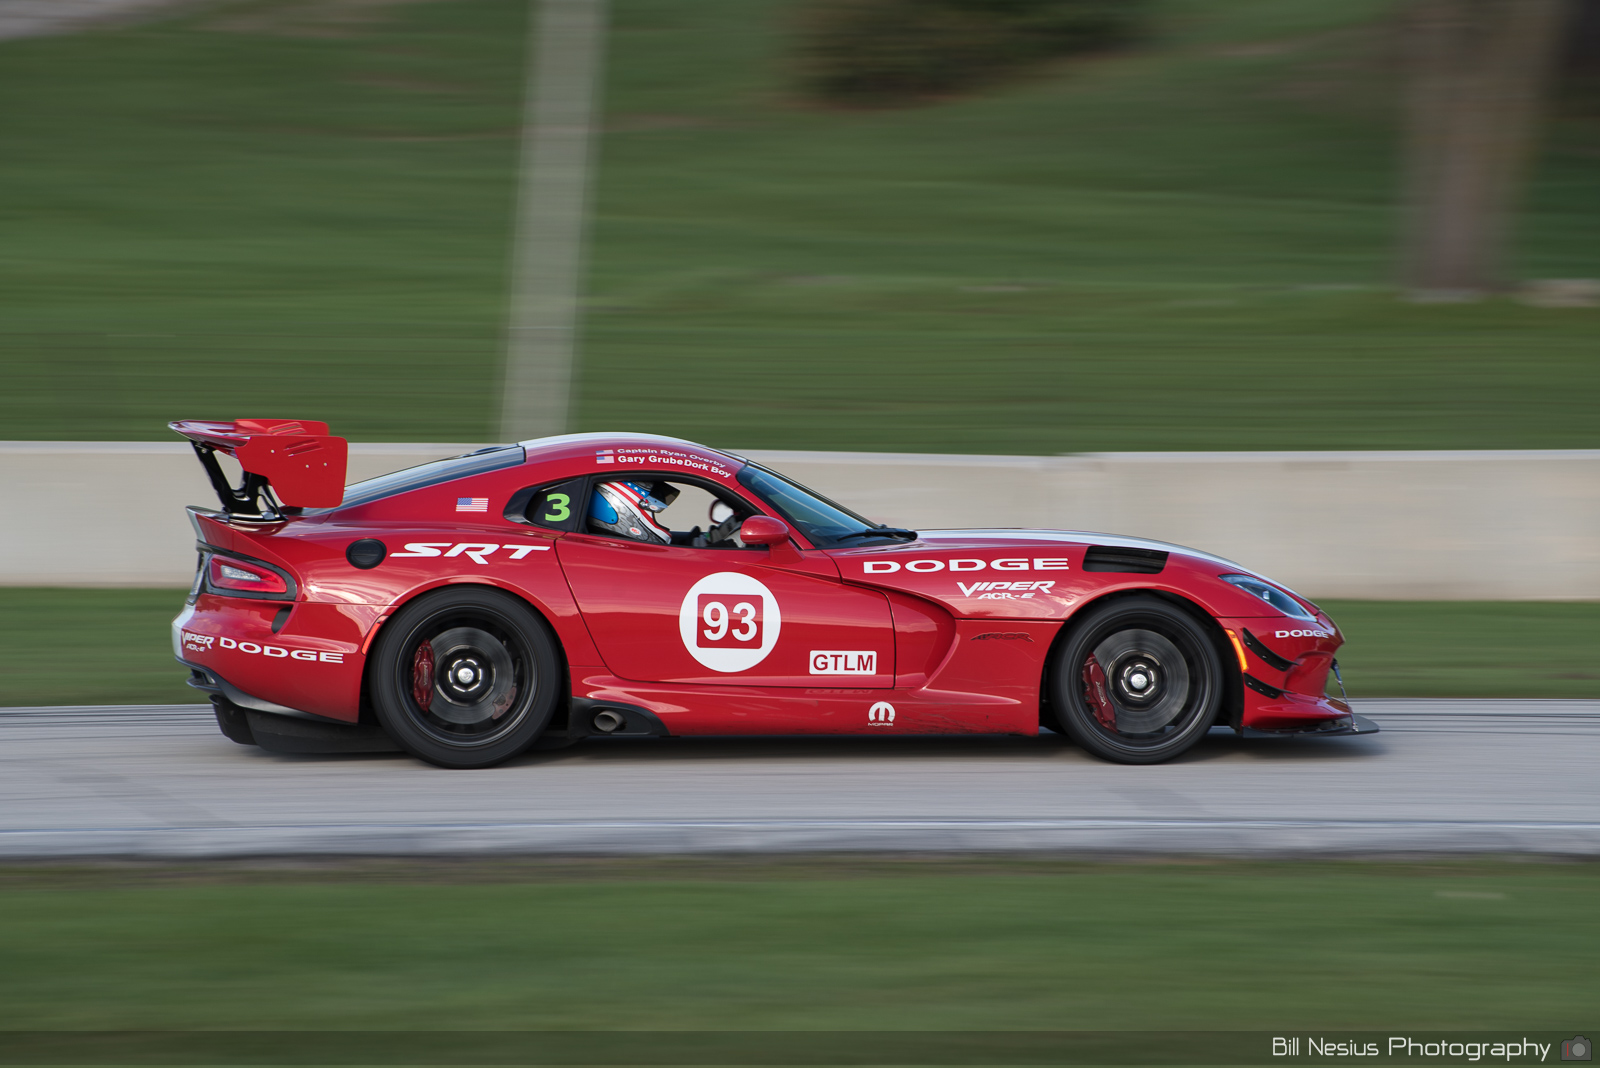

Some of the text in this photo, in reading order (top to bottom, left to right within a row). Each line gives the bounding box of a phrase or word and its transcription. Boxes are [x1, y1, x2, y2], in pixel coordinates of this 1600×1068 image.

[617, 455, 645, 464] Gary
[711, 466, 732, 478] Boy
[660, 449, 687, 458] Ryan
[689, 454, 726, 468] Overby
[544, 493, 571, 522] 3
[389, 542, 551, 565] SRT
[863, 558, 1070, 574] DODGE
[956, 580, 1056, 598] VIPER
[977, 592, 1036, 600] ACR-E
[703, 601, 758, 642] 93
[181, 630, 215, 650] VIPER
[1275, 629, 1329, 639] DODGE
[219, 636, 344, 664] DODGE
[813, 654, 874, 671] GTLM
